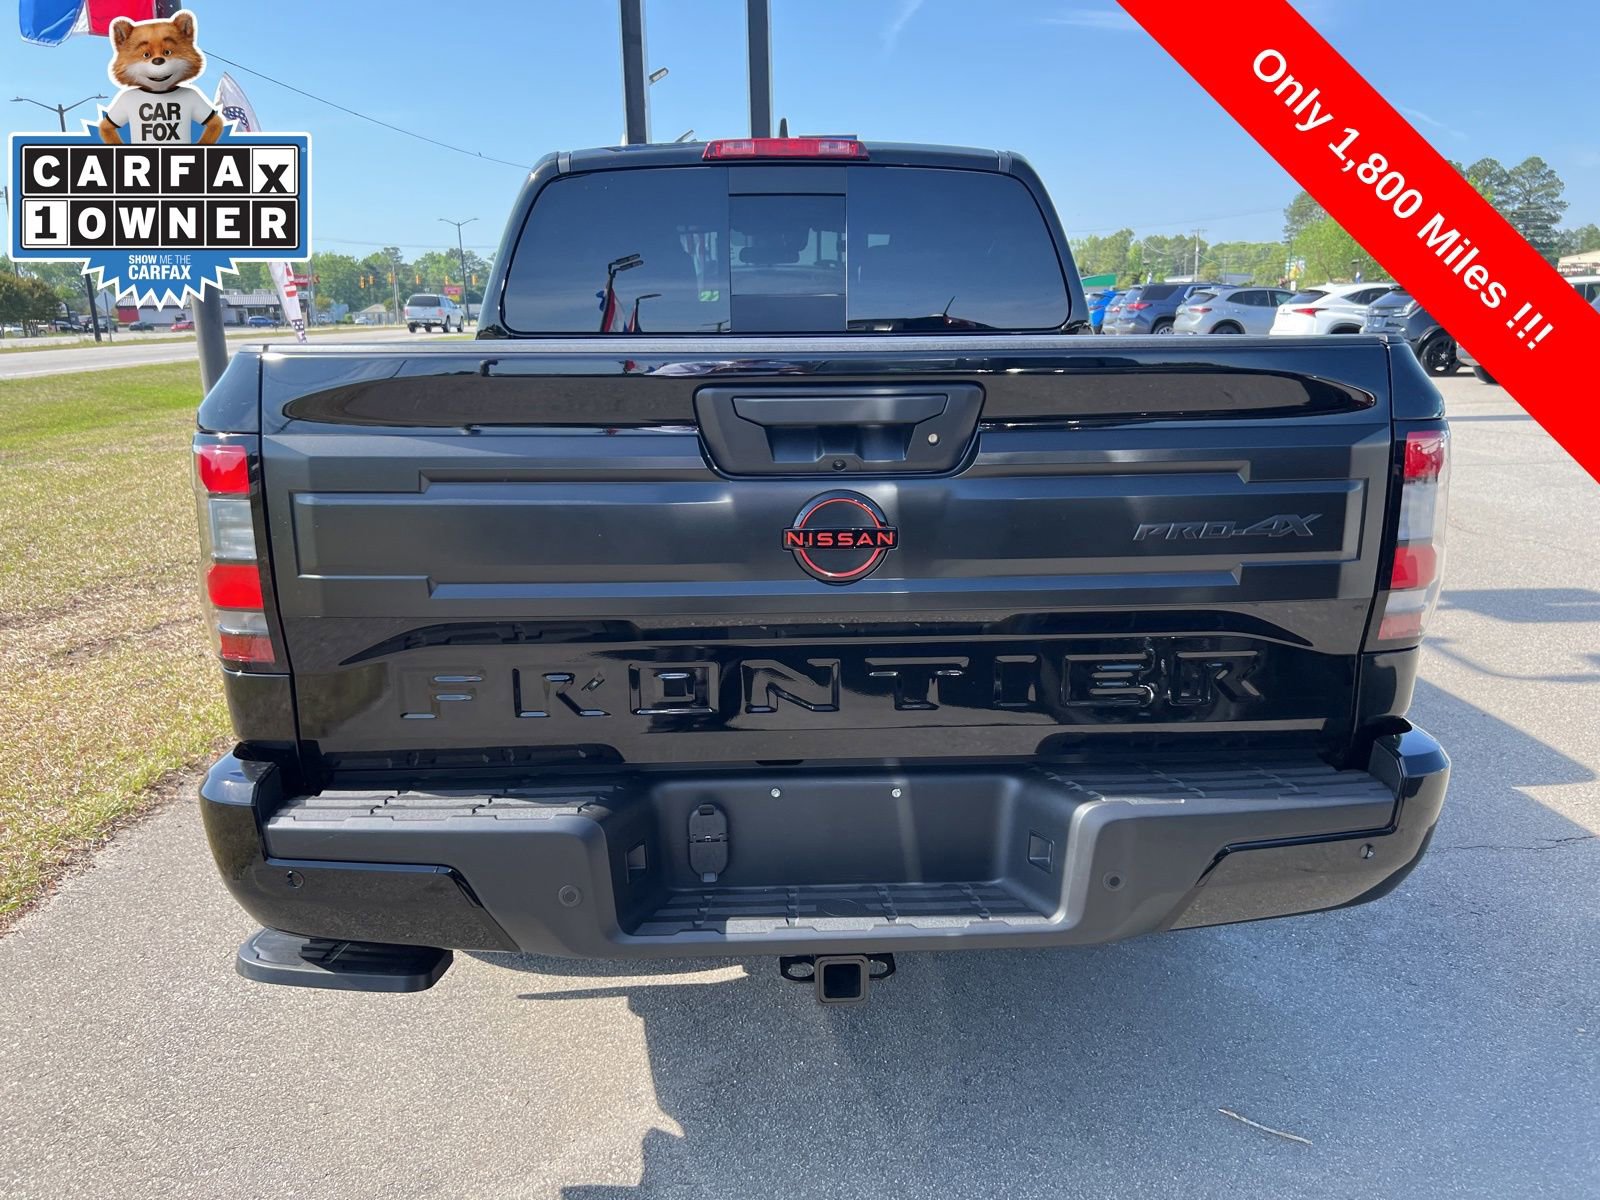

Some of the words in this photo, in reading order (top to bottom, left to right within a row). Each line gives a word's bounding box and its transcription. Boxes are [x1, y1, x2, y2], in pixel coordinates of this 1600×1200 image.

[787, 531, 895, 546] NISSAN
[1132, 513, 1323, 541] PRO-4X
[400, 650, 1266, 718] FRONTIER
